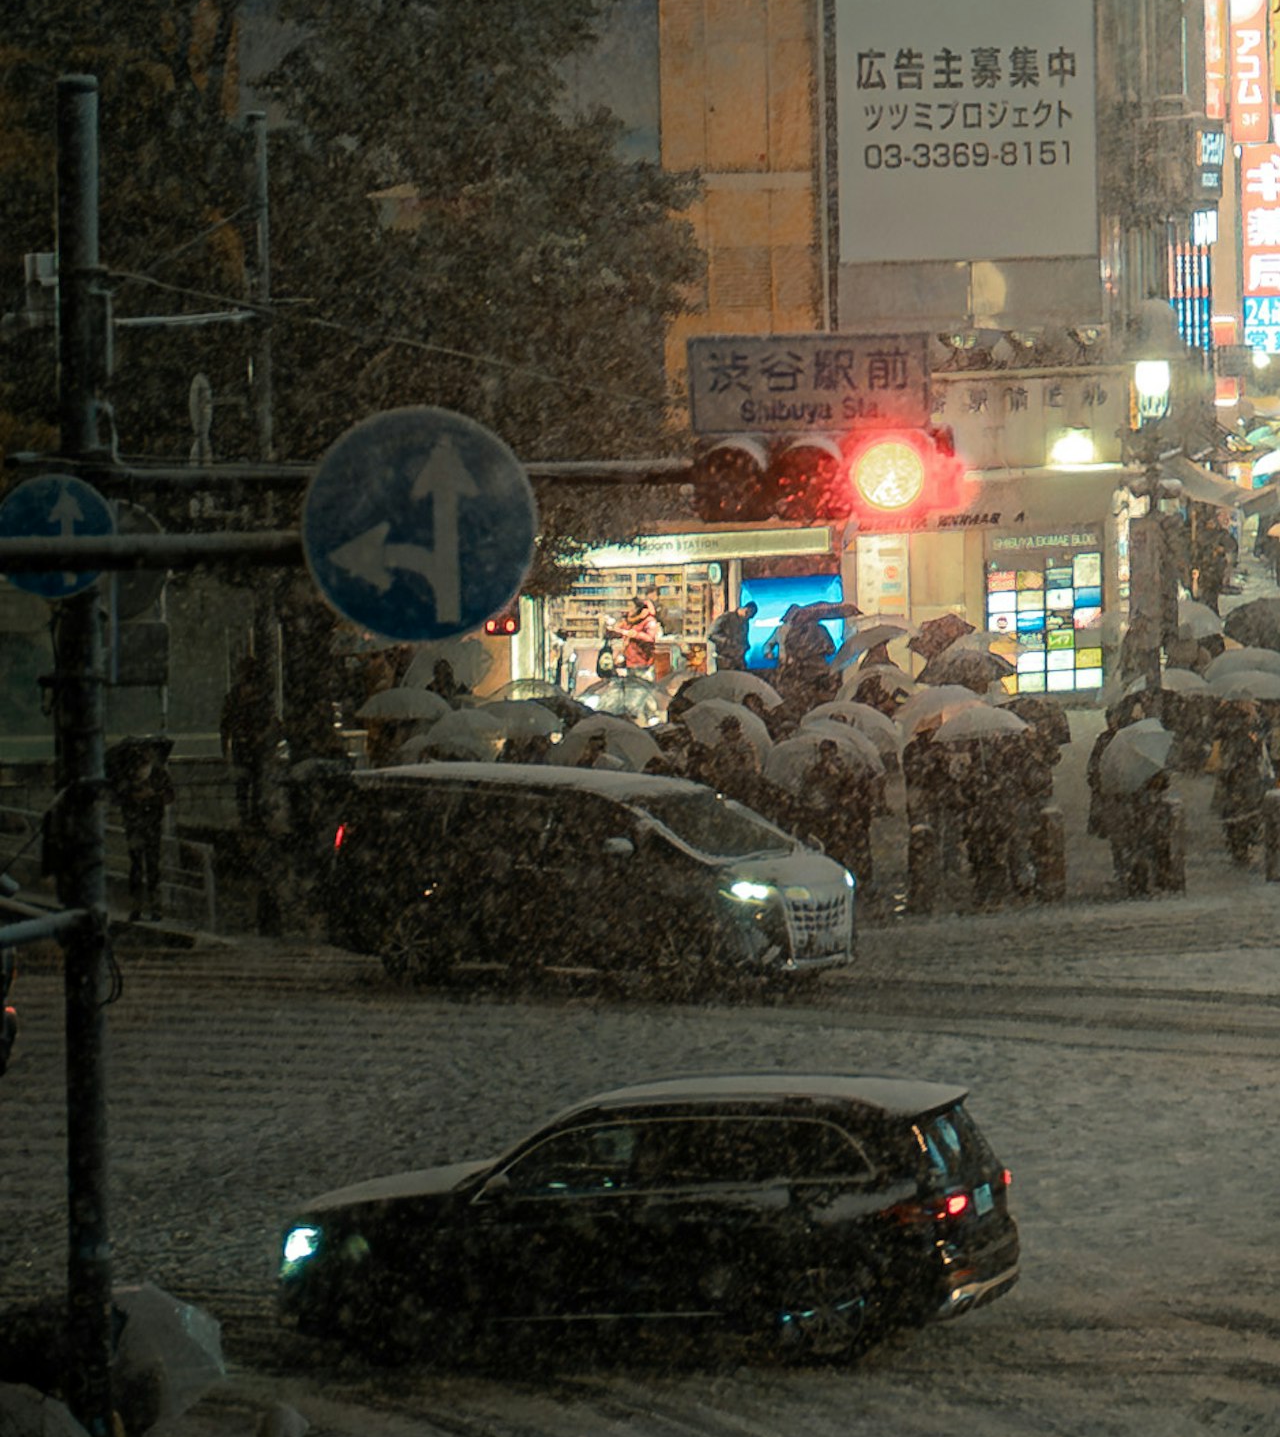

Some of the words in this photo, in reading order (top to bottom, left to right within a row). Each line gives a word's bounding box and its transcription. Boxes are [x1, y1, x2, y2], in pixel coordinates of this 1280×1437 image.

[856, 46, 1076, 90] 広告主募集中
[1235, 29, 1262, 105] アコム
[863, 99, 1073, 132] ツツミプロジェクト
[864, 140, 1071, 169] 03-3369-8151
[708, 350, 911, 393] 渋谷駅前
[740, 398, 831, 424] Shibuya
